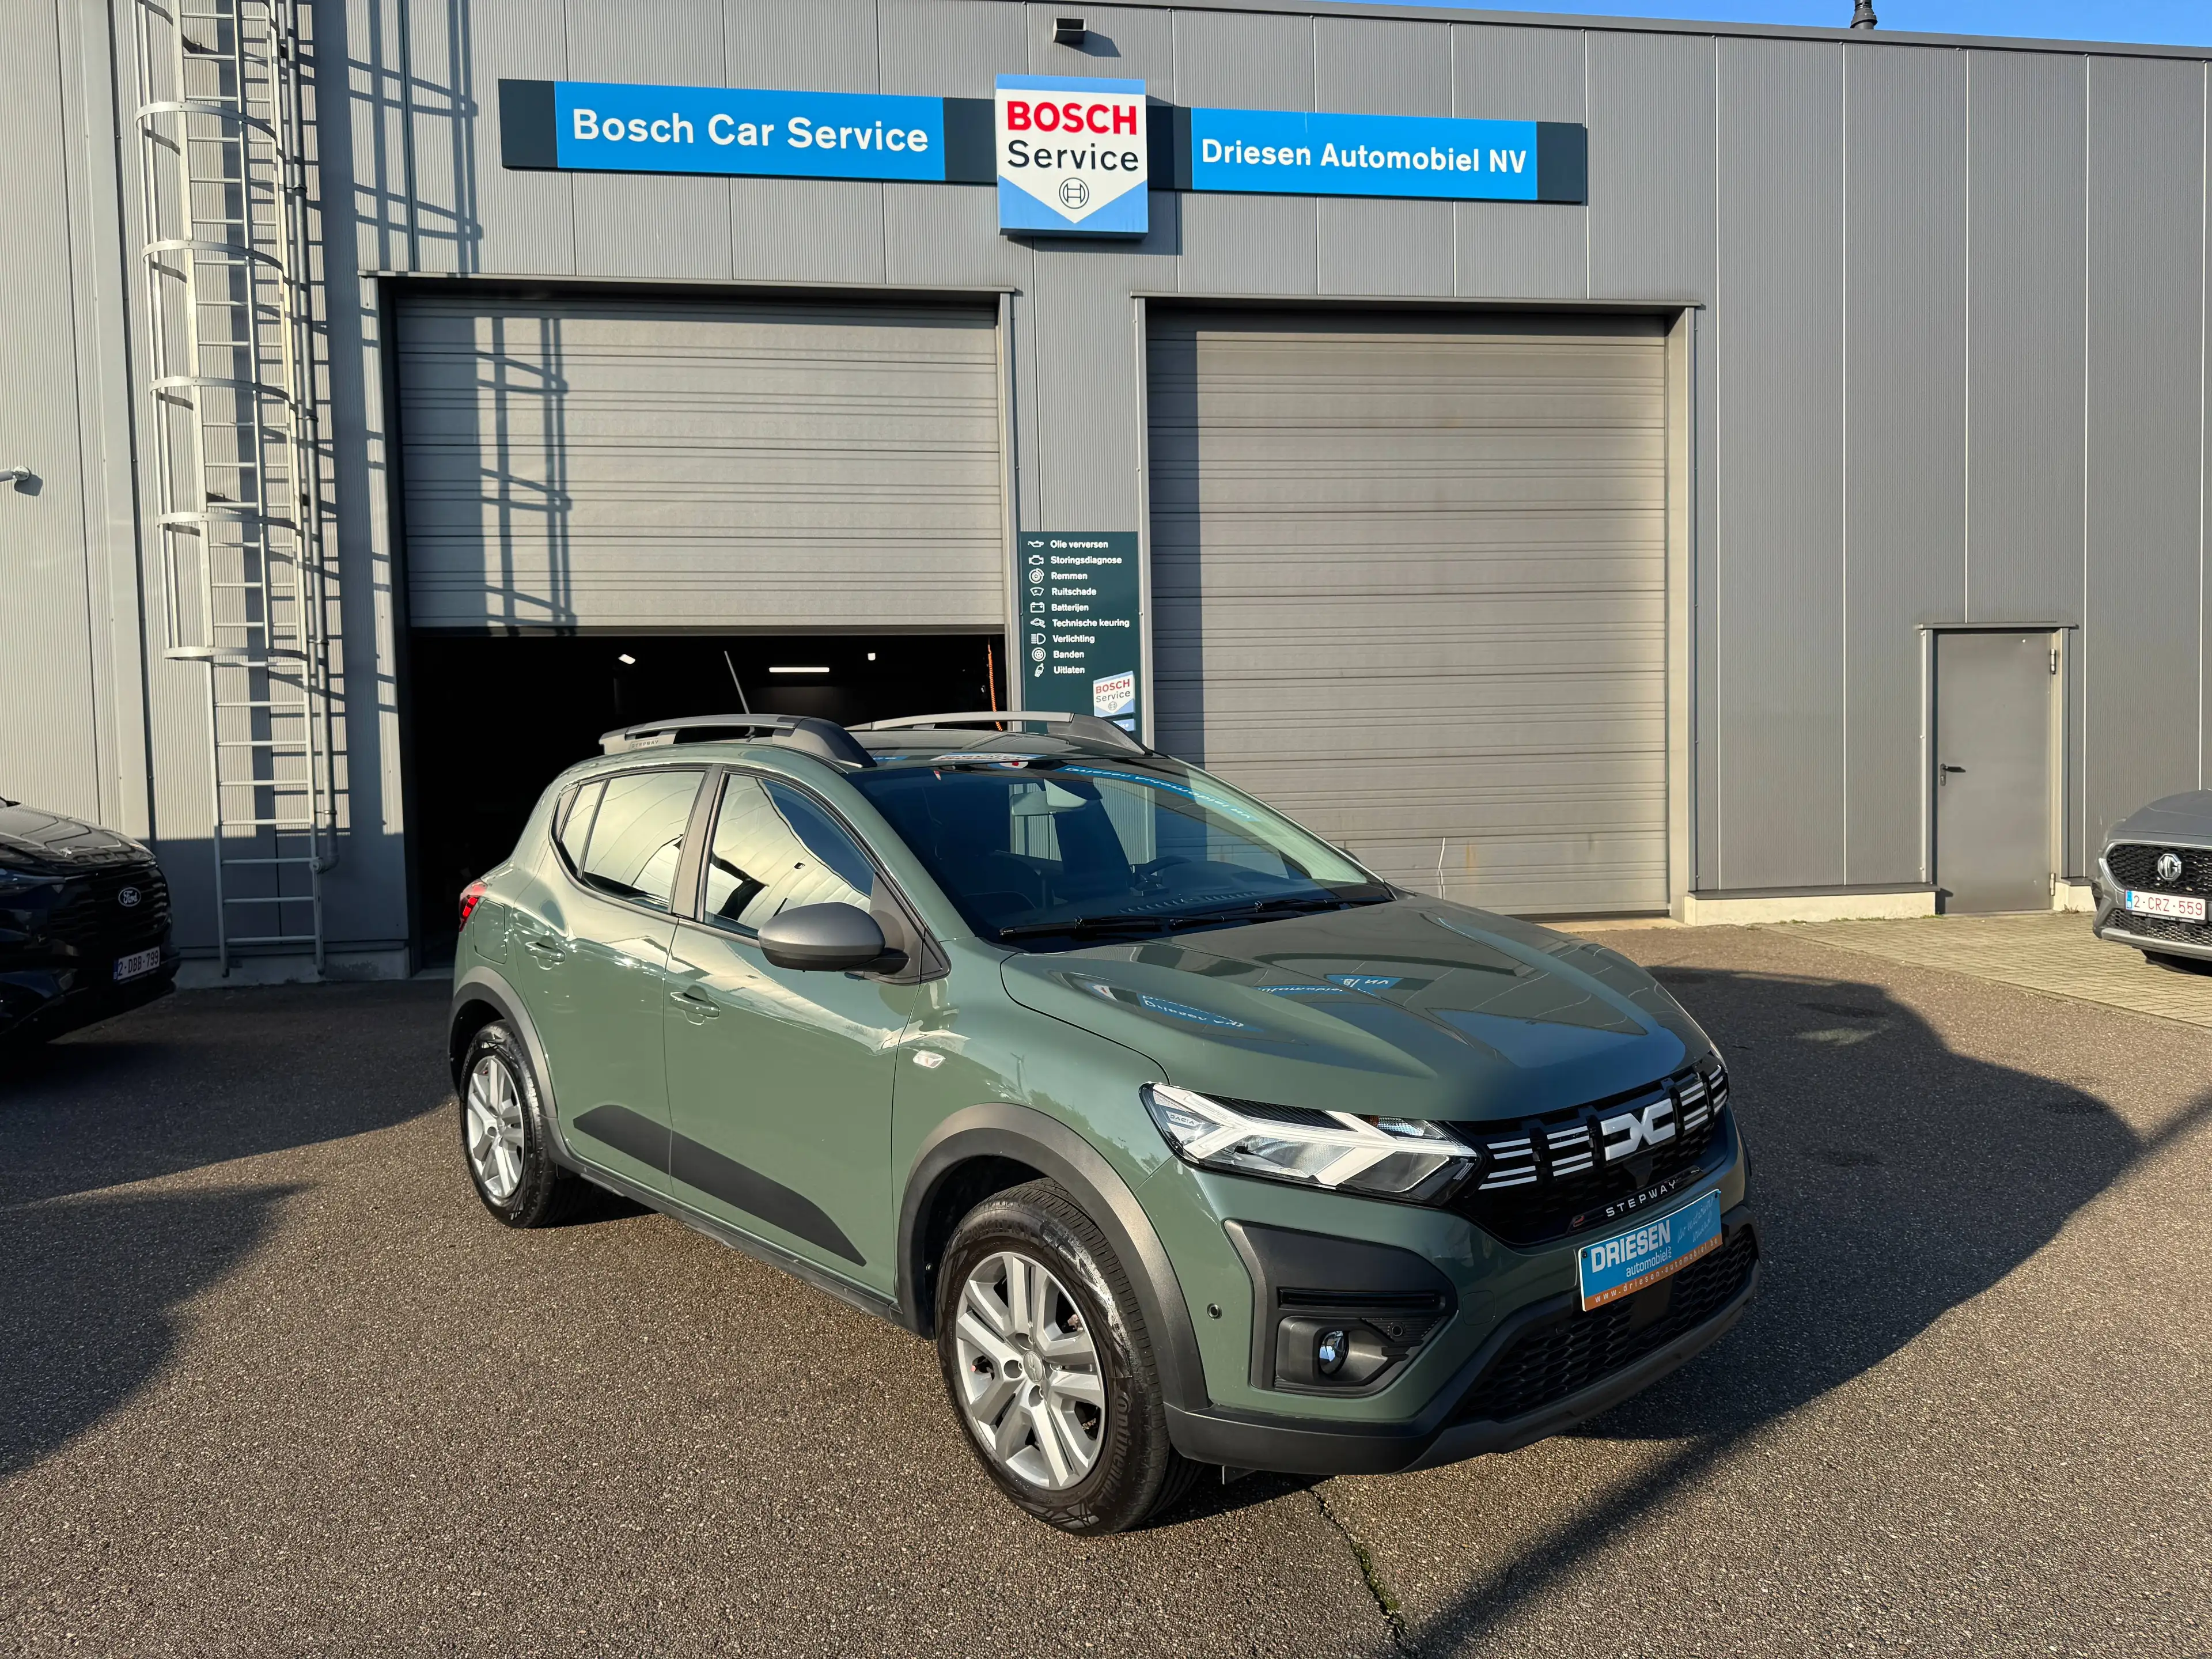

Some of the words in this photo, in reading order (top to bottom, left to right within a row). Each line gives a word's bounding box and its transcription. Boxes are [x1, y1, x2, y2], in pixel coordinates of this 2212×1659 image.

[1006, 101, 1137, 135] BOSCH
[573, 108, 694, 143] Bosch
[708, 113, 774, 146] Car
[787, 116, 929, 152] Service
[1007, 139, 1139, 172] Service
[1202, 138, 1310, 166] Driesen
[1320, 143, 1479, 172] Automobiel
[1490, 149, 1527, 173] NV
[1050, 540, 1067, 548] Olie
[1050, 555, 1123, 566] Storingsdiagnose
[1051, 571, 1088, 580] Remmen
[1051, 587, 1097, 596] Ruitschade
[1051, 603, 1089, 612] Batterijen
[1052, 619, 1097, 627] Technische
[1099, 619, 1130, 628] keuring
[1052, 634, 1095, 644] Verlichting
[1053, 650, 1085, 658] Banden
[1054, 666, 1085, 674] Uitlaten
[1096, 679, 1130, 694] BOSCH
[1096, 691, 1131, 703] Service
[2134, 895, 2203, 916] 2-CRZ-559
[118, 950, 158, 976] 2-DBB-799
[1170, 1114, 1195, 1125] DACIA
[1605, 1179, 1676, 1217] STEPWAY
[1590, 1219, 1671, 1273] DRIESEN
[1626, 1247, 1668, 1278] automobiel
[1595, 1237, 1718, 1303] www.driesen-automobiel.be
